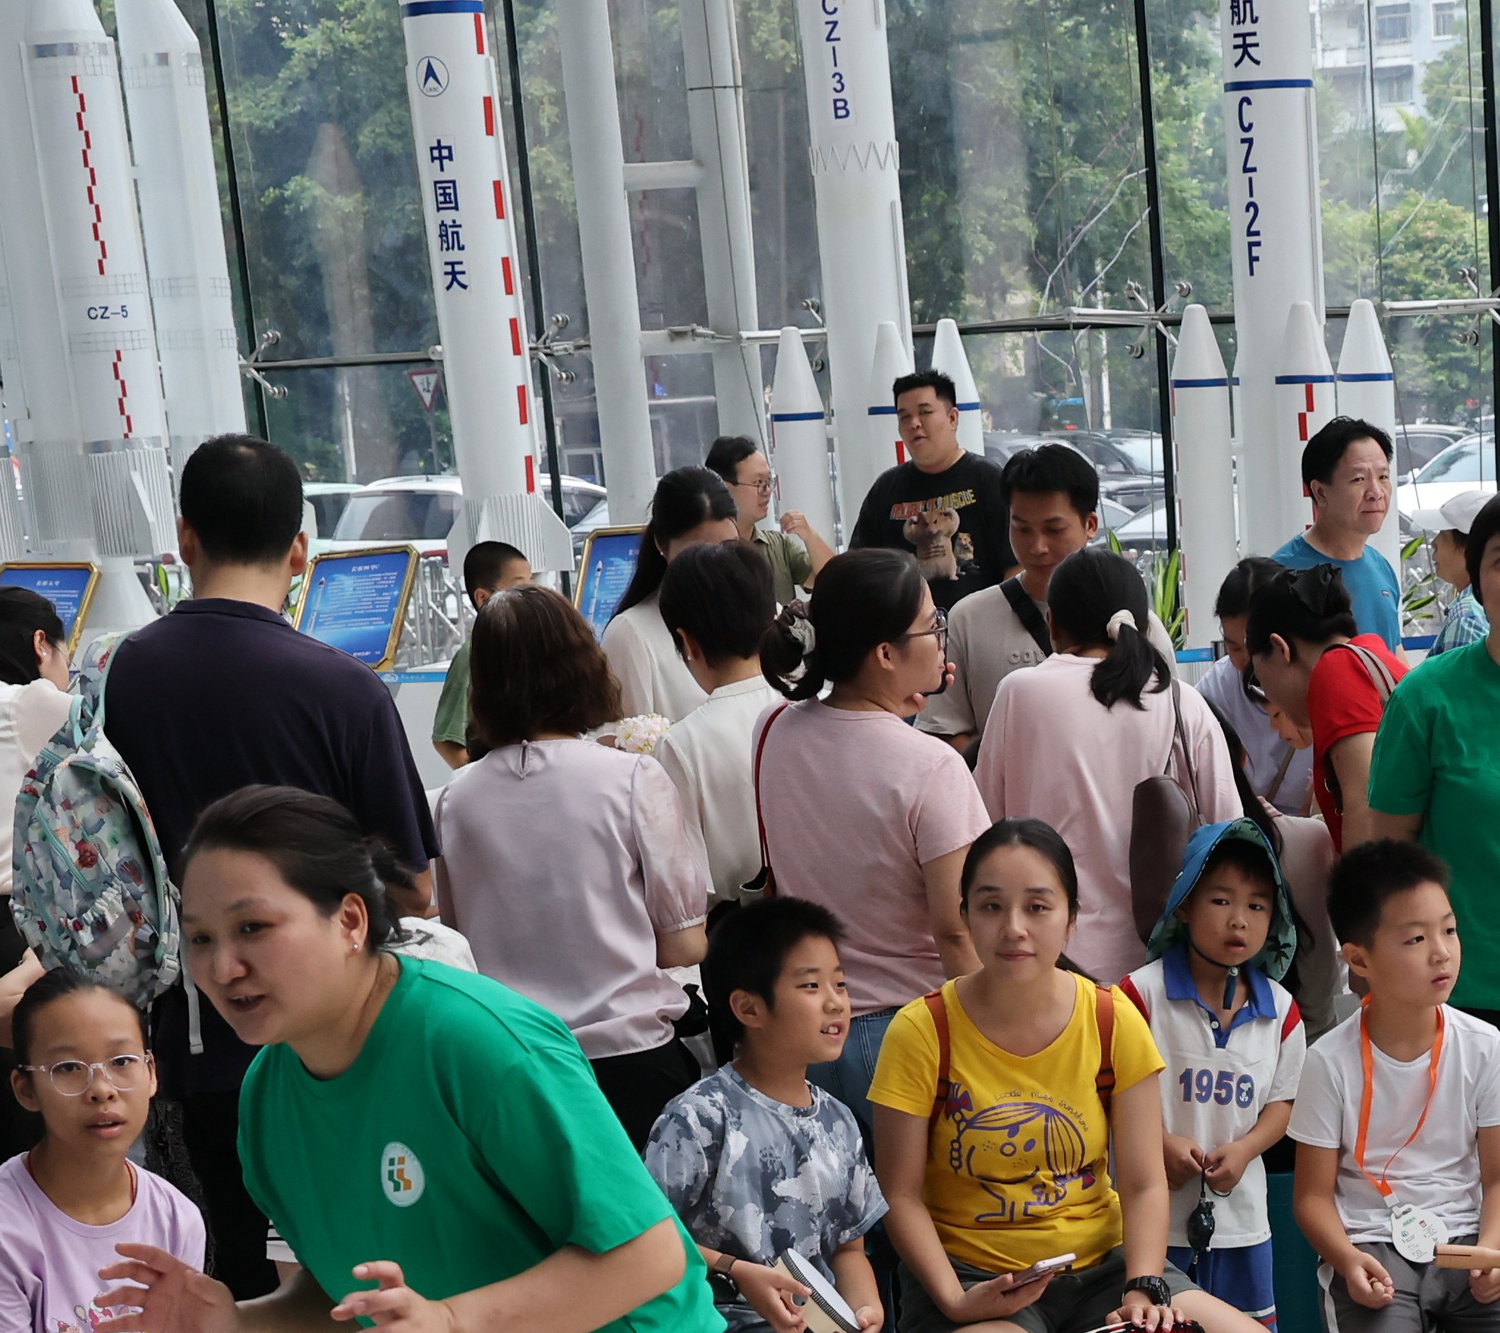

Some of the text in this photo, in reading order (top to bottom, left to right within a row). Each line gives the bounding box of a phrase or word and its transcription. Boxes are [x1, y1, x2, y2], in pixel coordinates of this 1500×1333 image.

[429, 138, 468, 291] 中国航天
[87, 305, 129, 320] CZ-5
[1178, 1067, 1255, 1109] 1950
